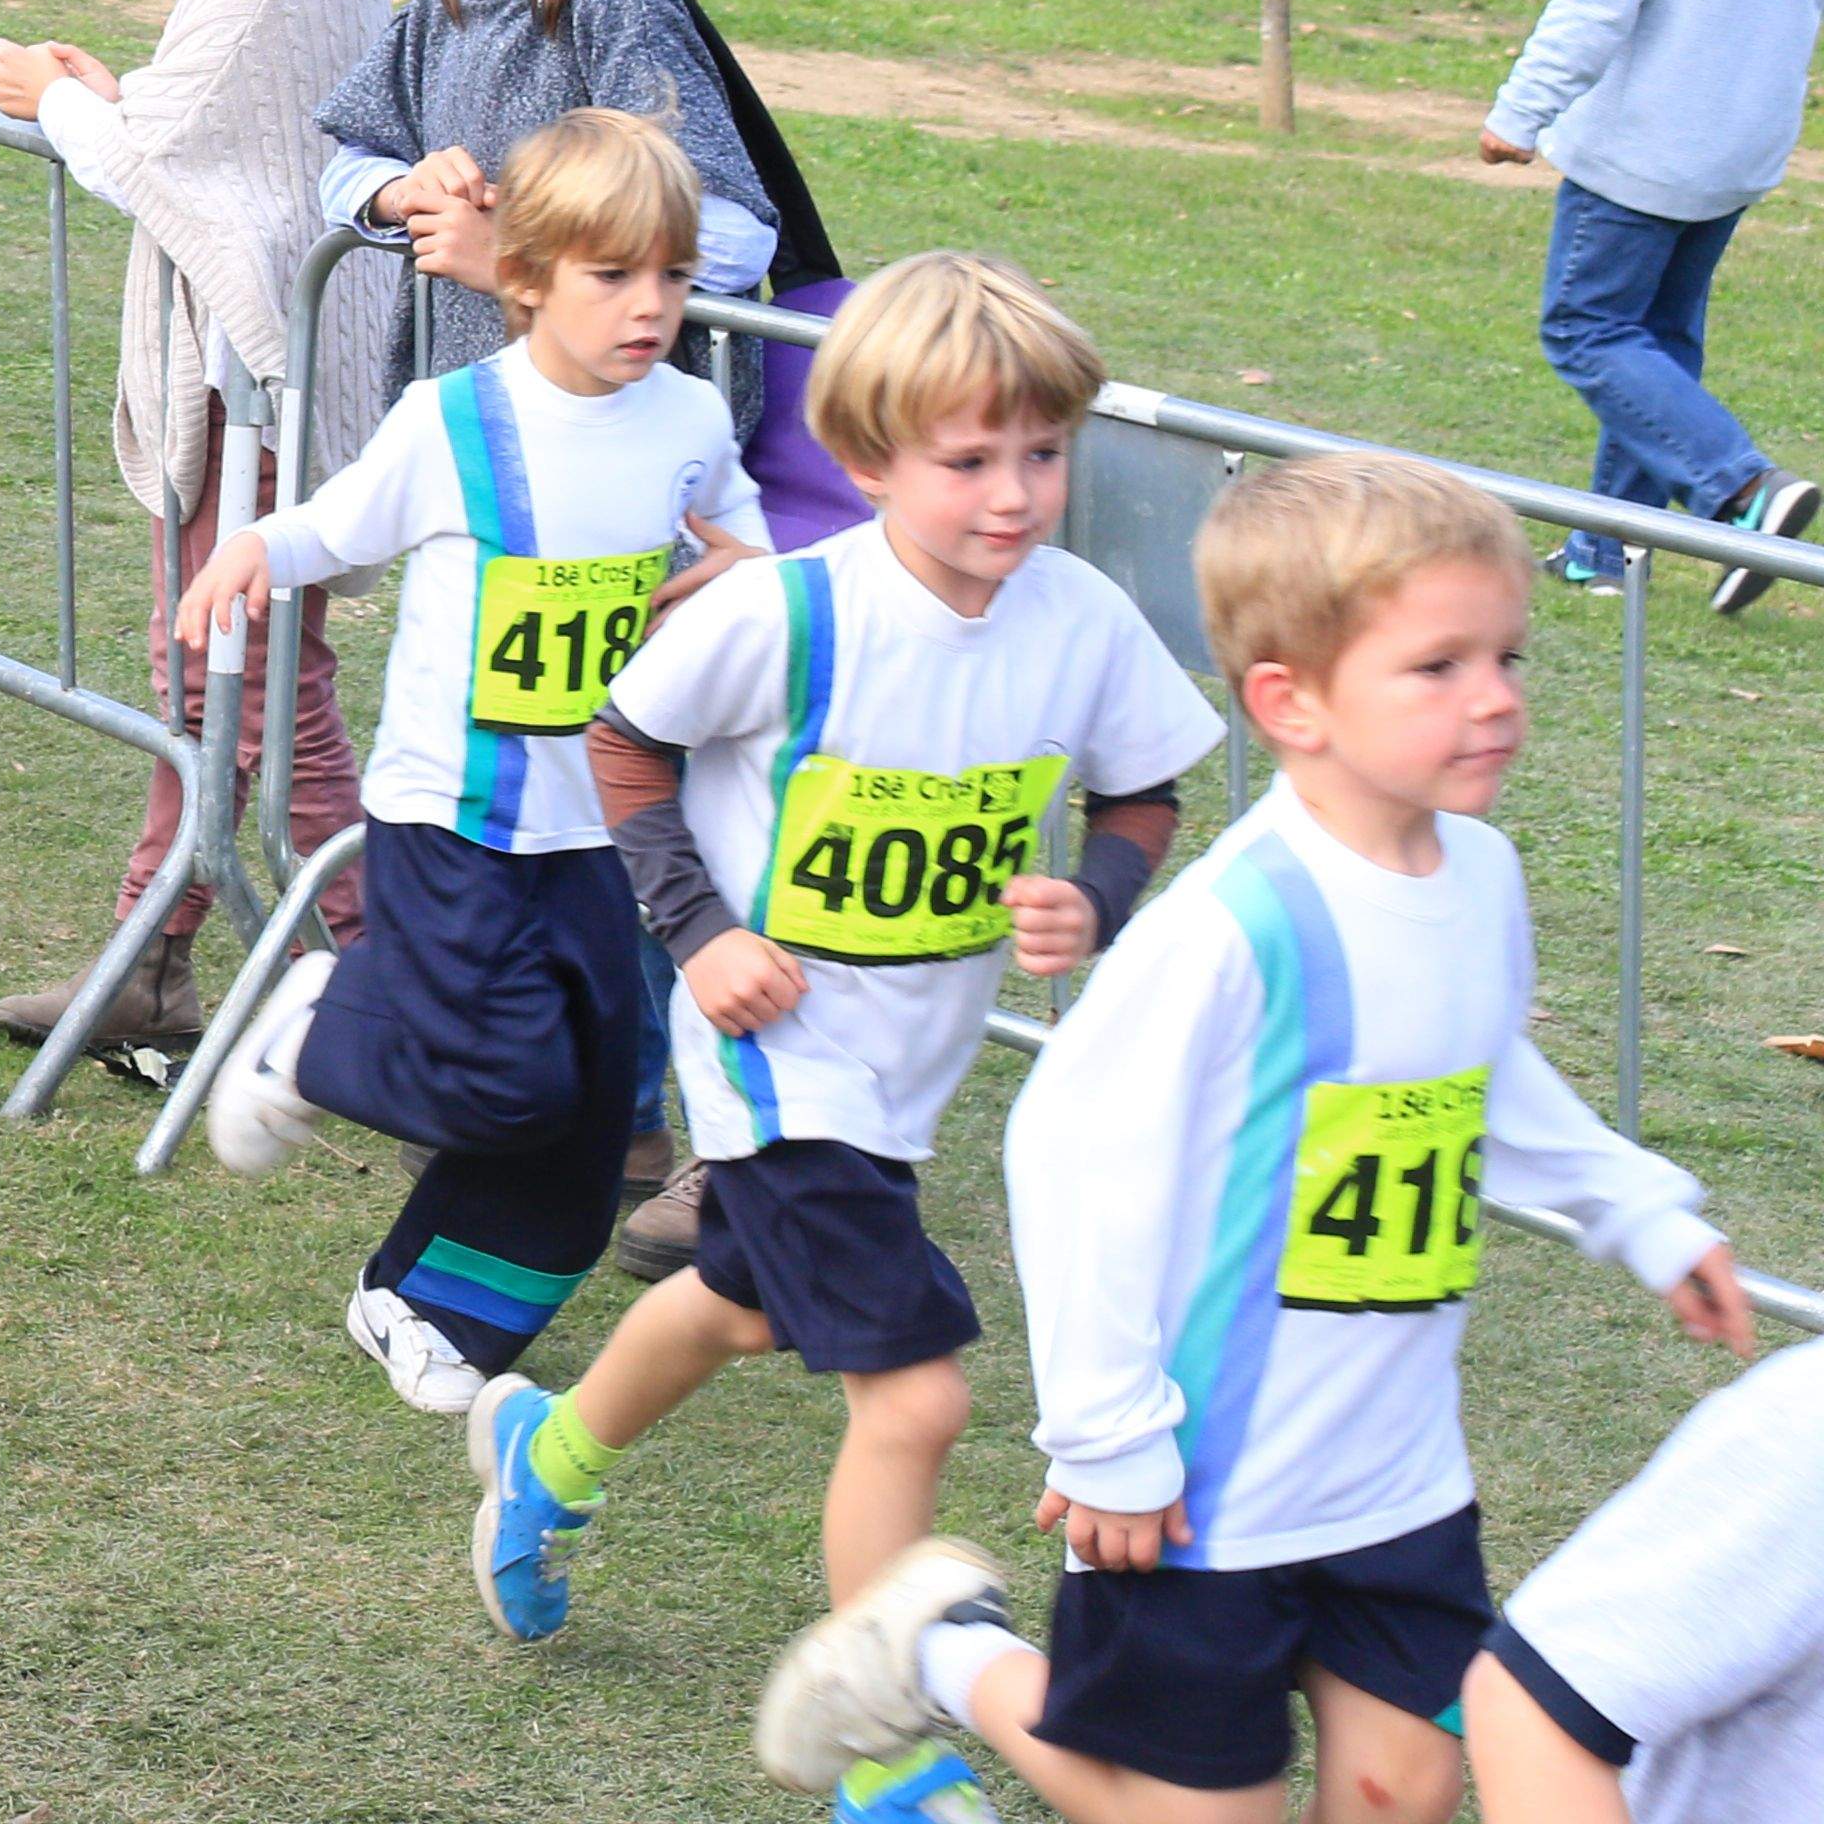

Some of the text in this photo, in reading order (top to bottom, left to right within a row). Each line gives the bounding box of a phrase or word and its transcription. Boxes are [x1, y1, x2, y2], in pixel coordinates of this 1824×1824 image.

[536, 562, 633, 587] 18è Cros
[851, 774, 905, 800] 18è
[792, 816, 1030, 918] 4085
